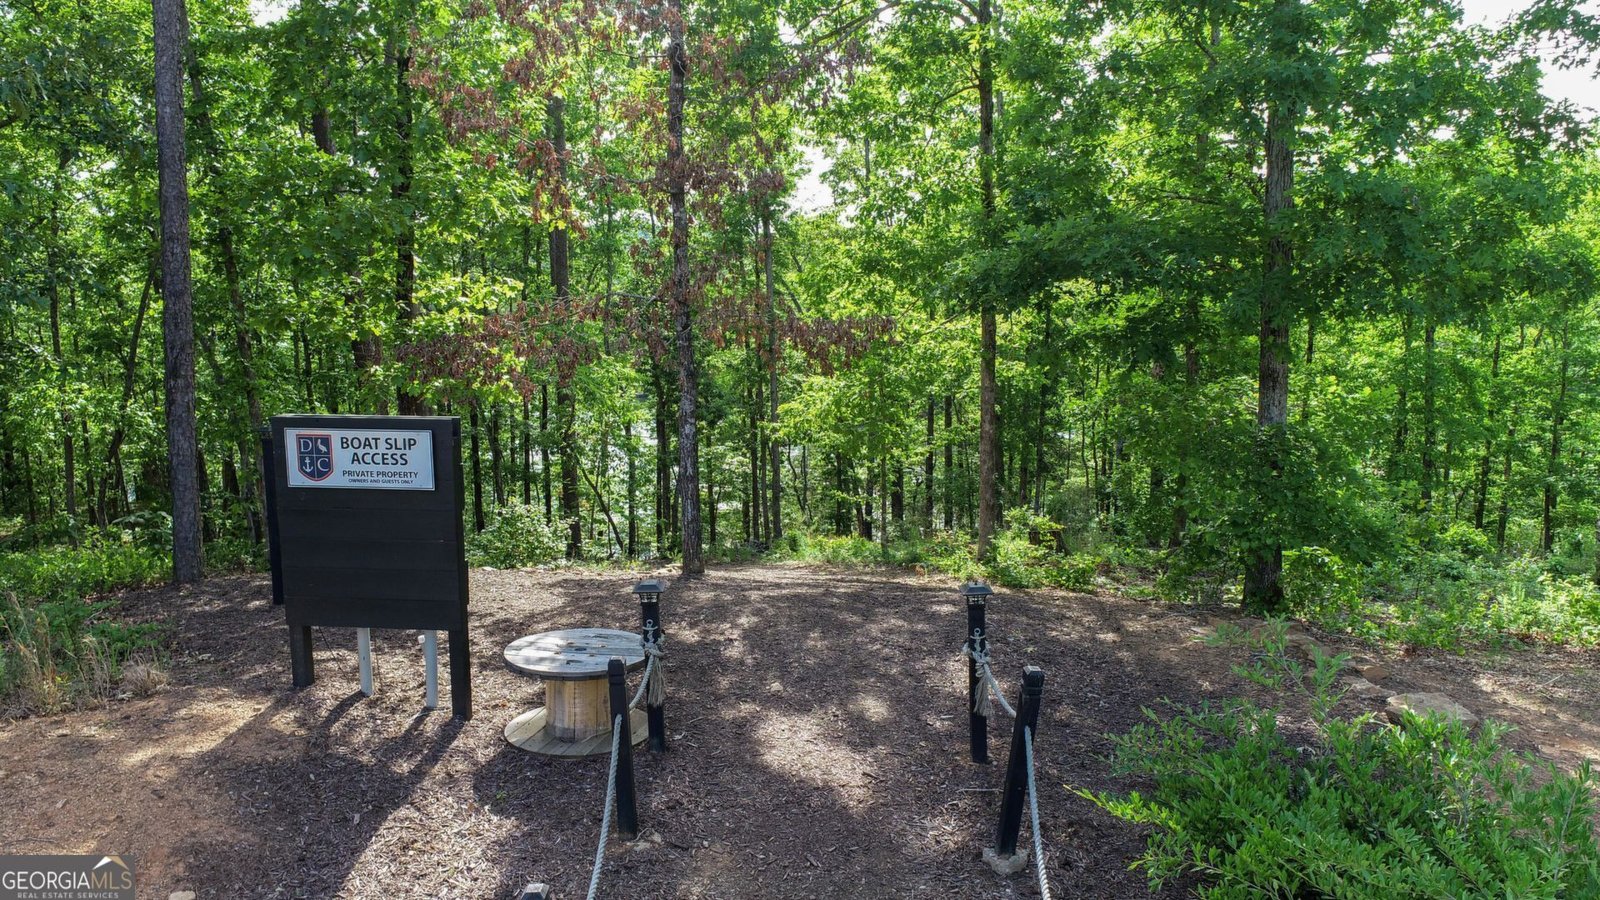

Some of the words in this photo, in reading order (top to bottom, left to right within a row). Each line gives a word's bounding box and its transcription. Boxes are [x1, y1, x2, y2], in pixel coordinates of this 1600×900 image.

[300, 438, 312, 452] D
[340, 436, 380, 450] BOAT
[385, 437, 417, 451] SLIP
[317, 457, 330, 472] C
[351, 452, 408, 466] ACCESS
[342, 470, 375, 478] PRIVATE
[376, 470, 418, 479] PROPERTY
